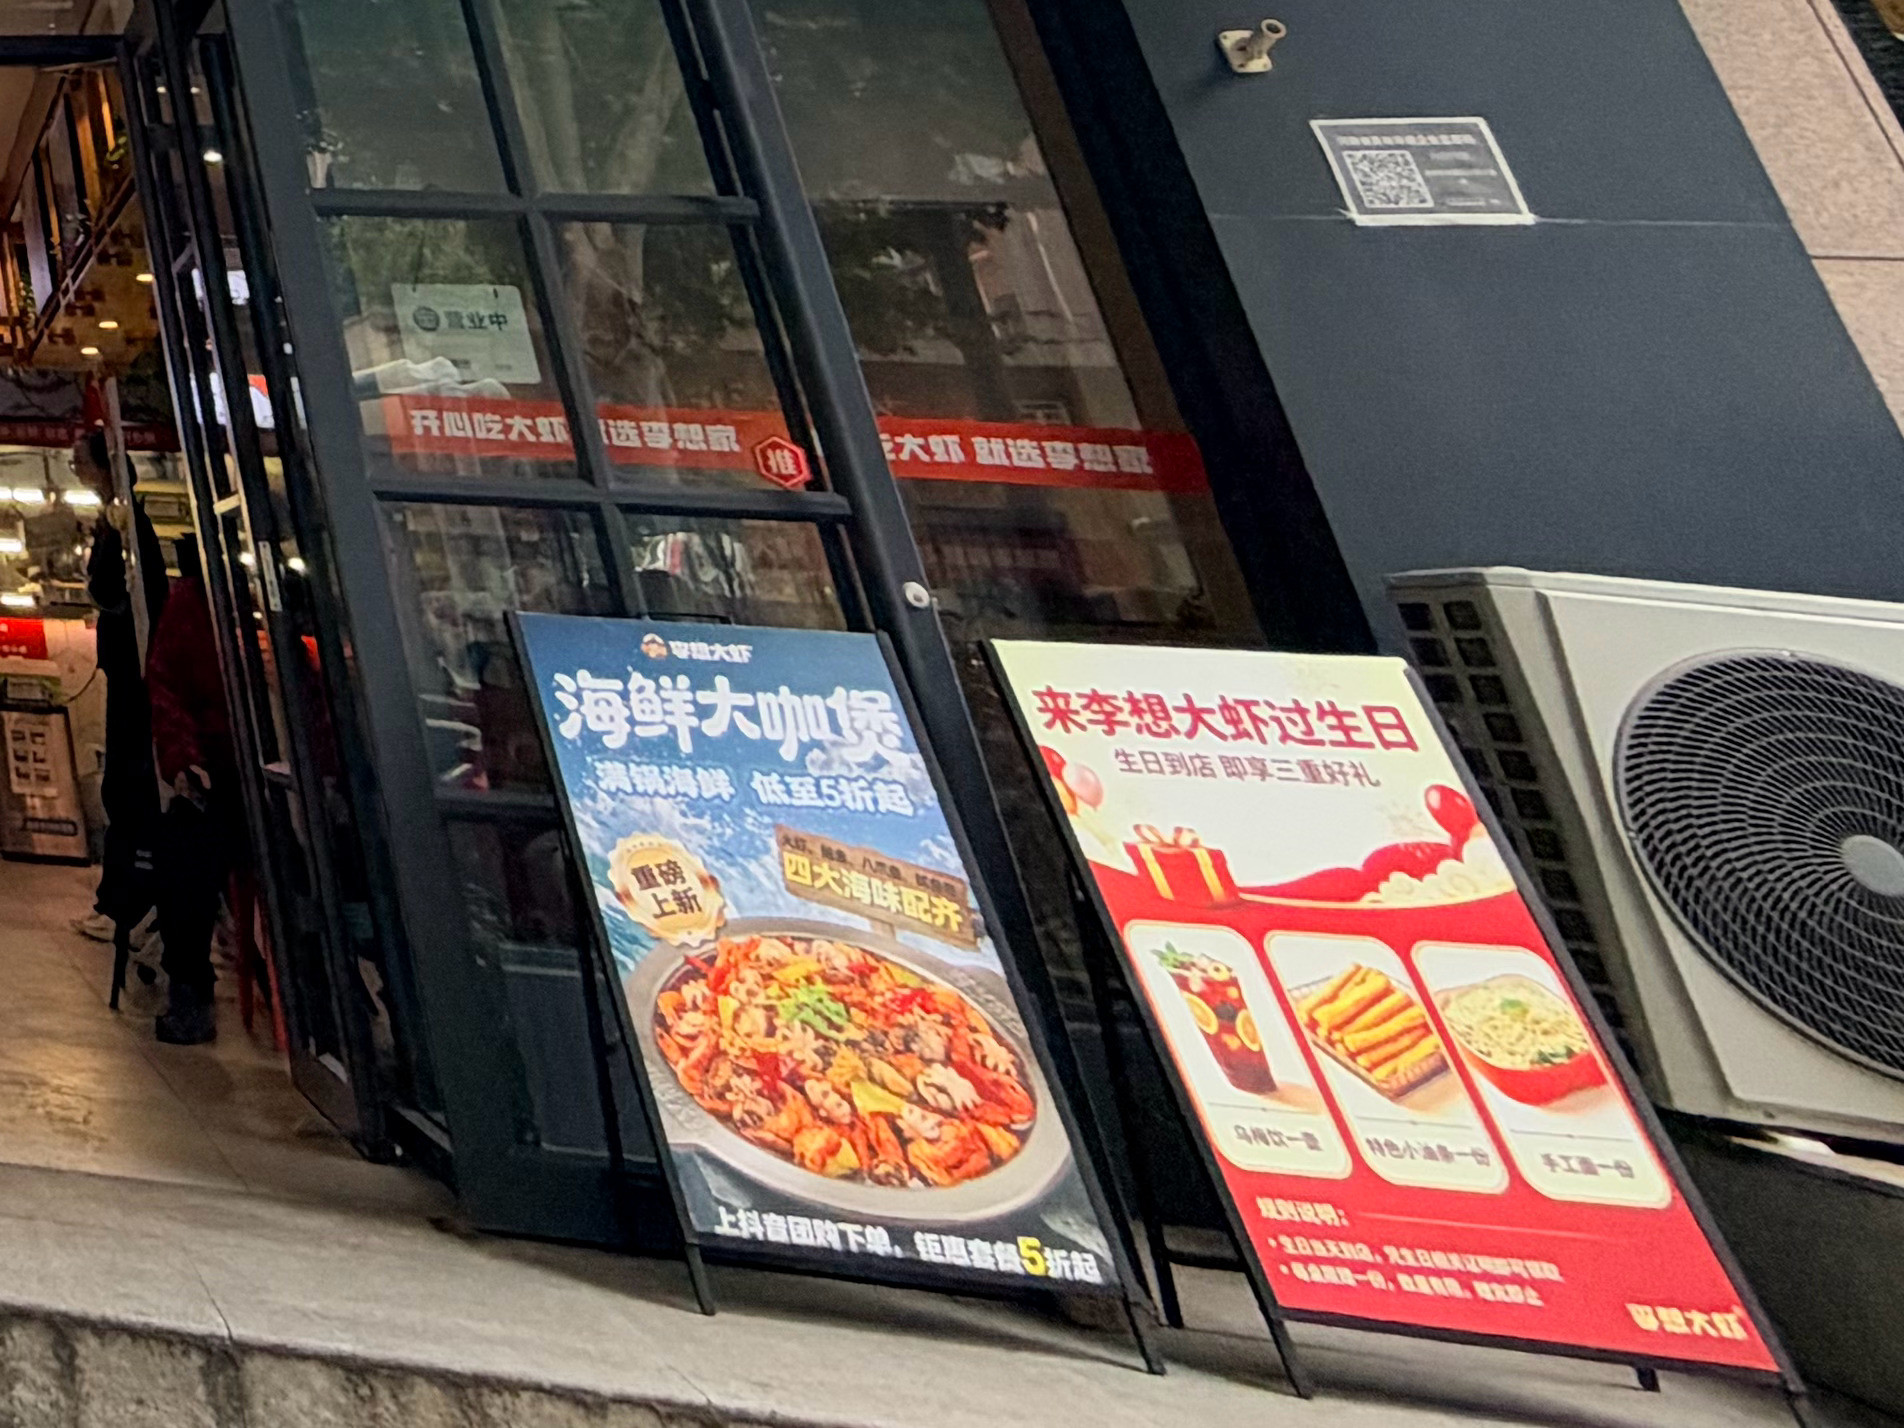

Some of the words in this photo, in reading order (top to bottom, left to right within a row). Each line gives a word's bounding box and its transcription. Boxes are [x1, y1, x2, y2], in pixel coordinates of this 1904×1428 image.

[444, 310, 508, 331] 营业中
[410, 409, 570, 443] 开心吃大虾
[769, 448, 797, 475] 推
[972, 436, 1154, 474] 就选李想家
[554, 668, 902, 762] 海鲜大咖煲
[1032, 685, 1420, 753] 来李想大虾过生日
[1114, 748, 1216, 780] 生日到店
[1222, 756, 1382, 789] 即享三重好礼
[594, 760, 736, 800] 满锅海鲜
[752, 770, 914, 817] 低至5折起
[631, 859, 687, 891] 重磅
[782, 851, 962, 932] 四大海味配齐
[651, 887, 702, 919] 上新
